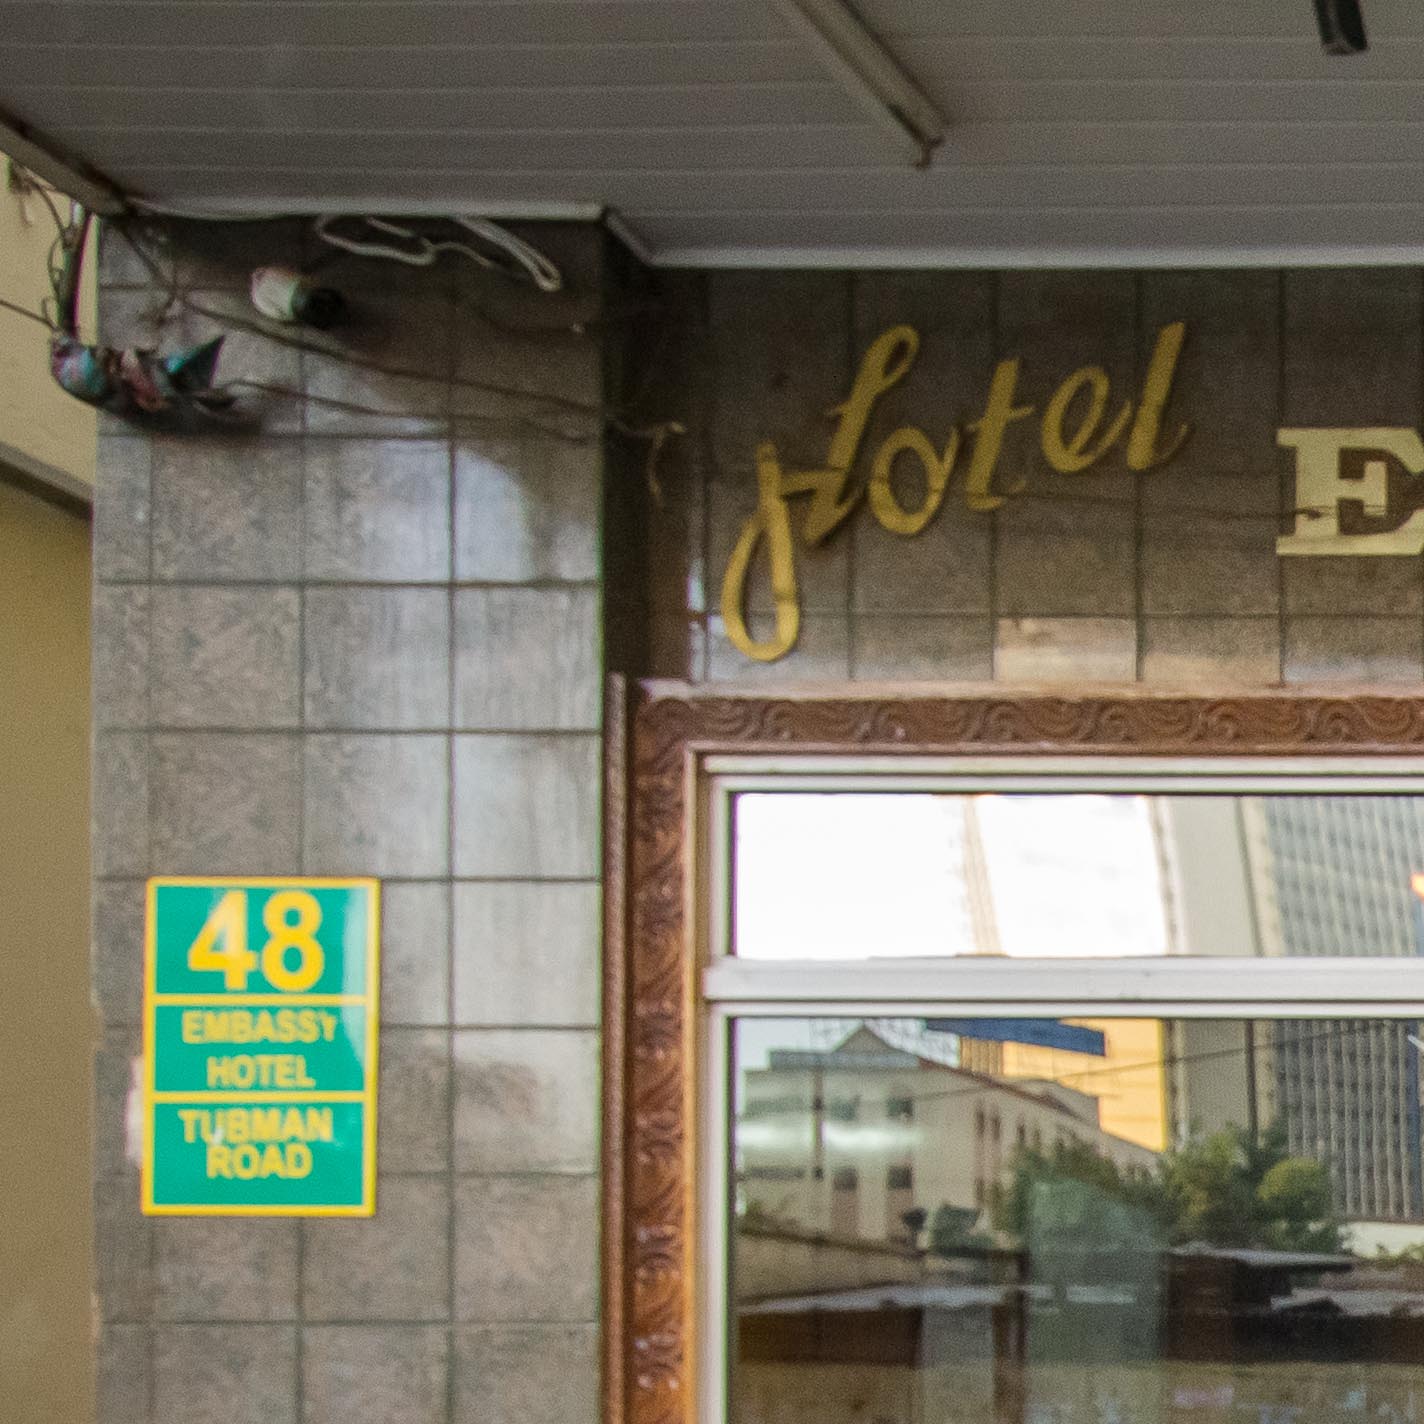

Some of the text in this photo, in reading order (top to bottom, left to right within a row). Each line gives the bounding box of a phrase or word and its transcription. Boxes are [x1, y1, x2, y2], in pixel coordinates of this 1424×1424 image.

[721, 322, 1190, 663] Hotel
[187, 888, 325, 993] 48
[182, 1009, 337, 1044] EMBASSY
[206, 1054, 316, 1089] HOTEL
[178, 1107, 334, 1144] TUBMAN
[206, 1144, 313, 1180] ROAD
